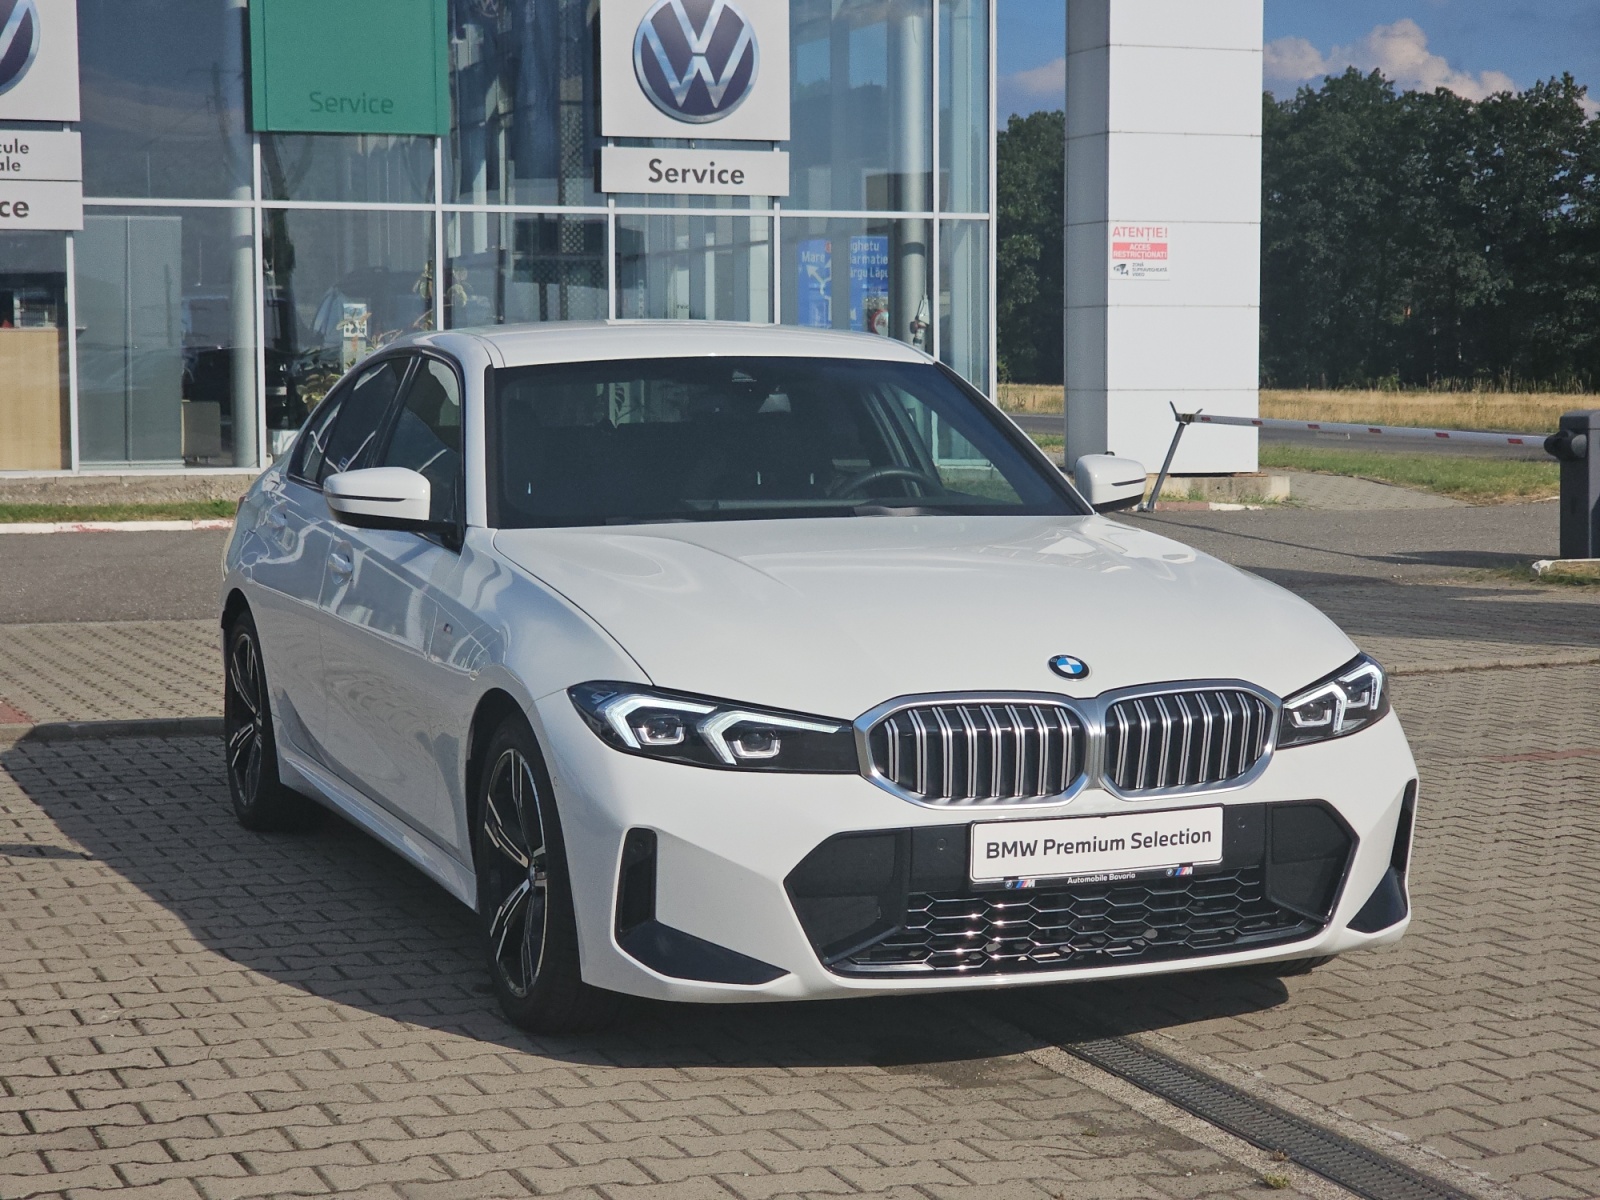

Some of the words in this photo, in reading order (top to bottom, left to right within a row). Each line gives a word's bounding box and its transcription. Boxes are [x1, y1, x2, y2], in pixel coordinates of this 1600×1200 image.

[309, 91, 394, 114] Service
[0, 138, 29, 154] ule
[648, 158, 745, 185] Service
[802, 251, 825, 262] Mare
[986, 839, 1038, 859] BMW
[1043, 835, 1125, 856] Premium
[1130, 828, 1212, 850] Selection
[1067, 874, 1107, 885] Automobile
